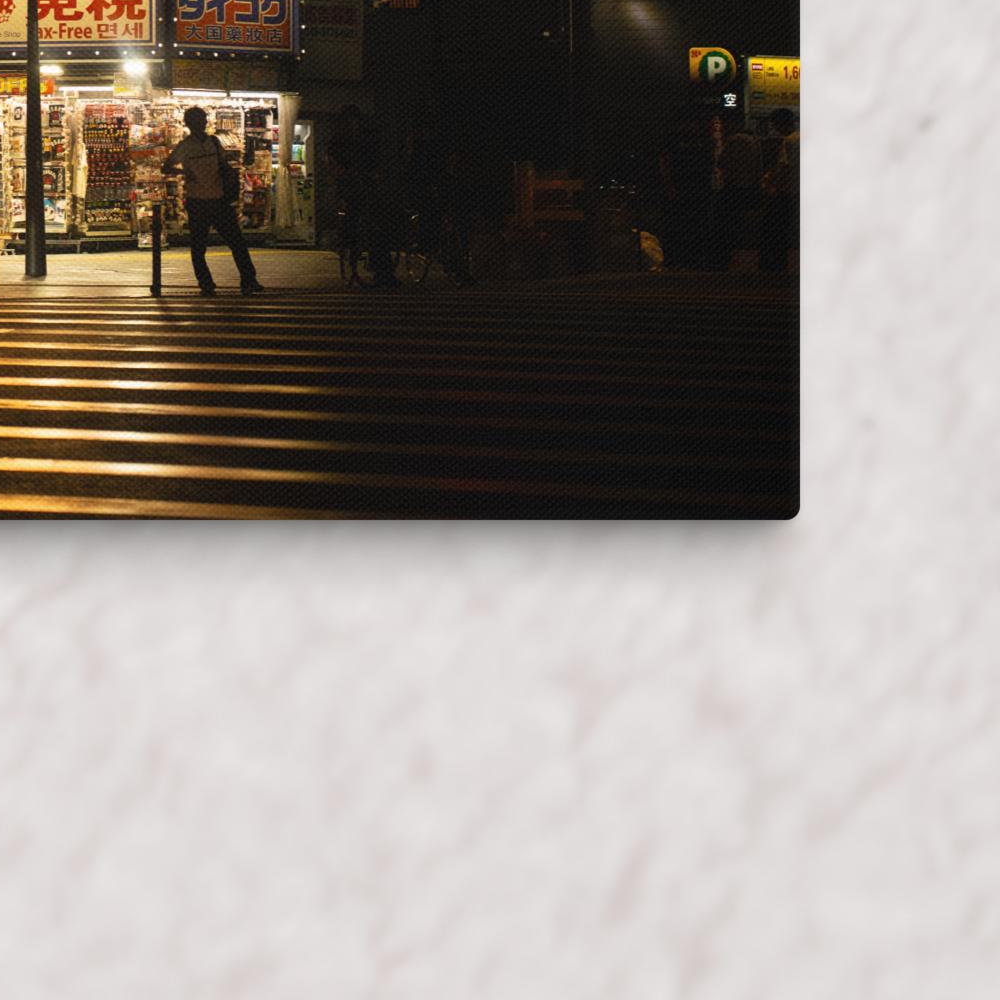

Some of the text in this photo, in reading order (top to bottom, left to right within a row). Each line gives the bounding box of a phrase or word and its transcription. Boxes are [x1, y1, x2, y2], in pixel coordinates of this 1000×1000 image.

[26, 22, 144, 41] ax-Free 면세
[706, 55, 727, 82] P
[783, 65, 800, 81] 1,6
[723, 92, 737, 107] 空
